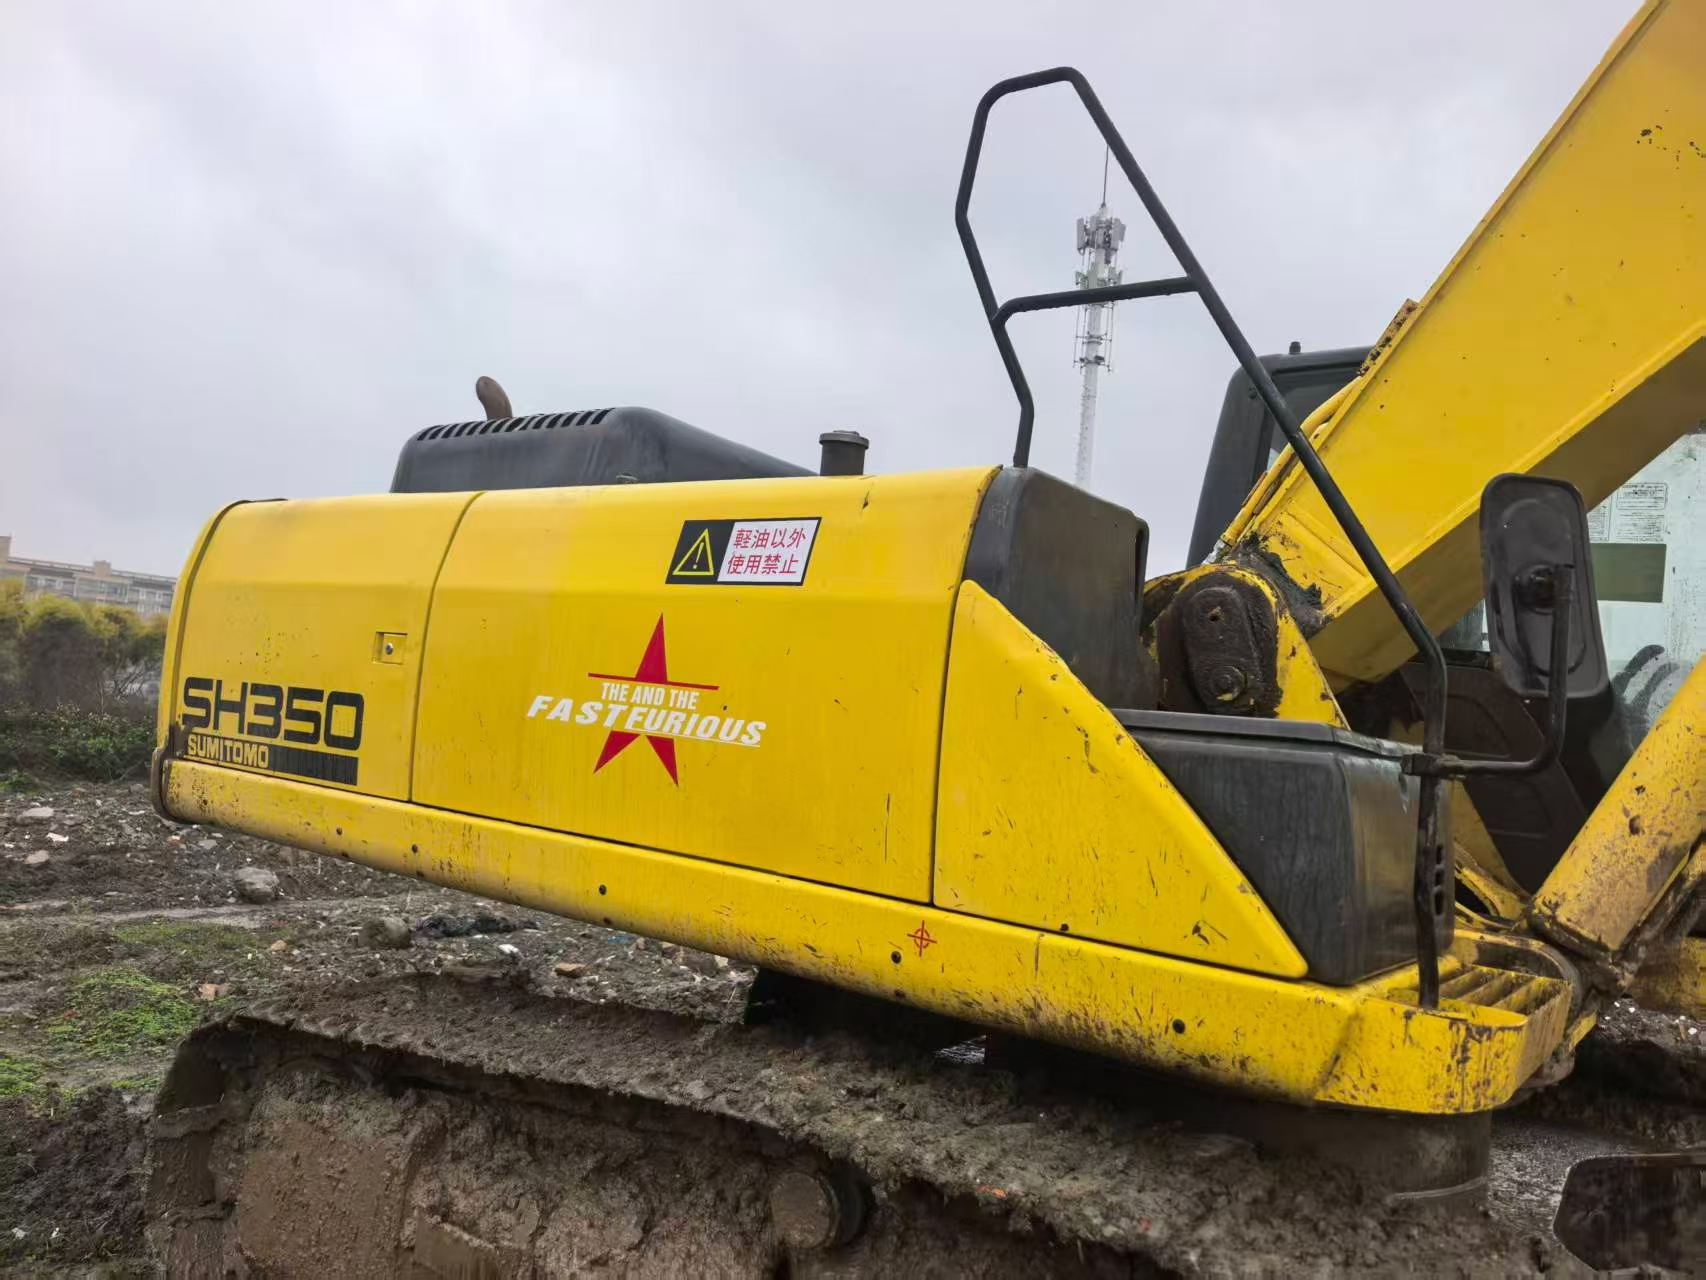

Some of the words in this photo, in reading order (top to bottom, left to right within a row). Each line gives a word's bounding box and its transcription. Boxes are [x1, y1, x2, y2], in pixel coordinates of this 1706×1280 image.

[727, 552, 799, 575] 使用禁止
[601, 682, 630, 703] THE
[630, 685, 665, 706] AND
[669, 689, 700, 710] THE
[182, 676, 365, 751] SH350
[187, 733, 269, 769] SUMITOMO
